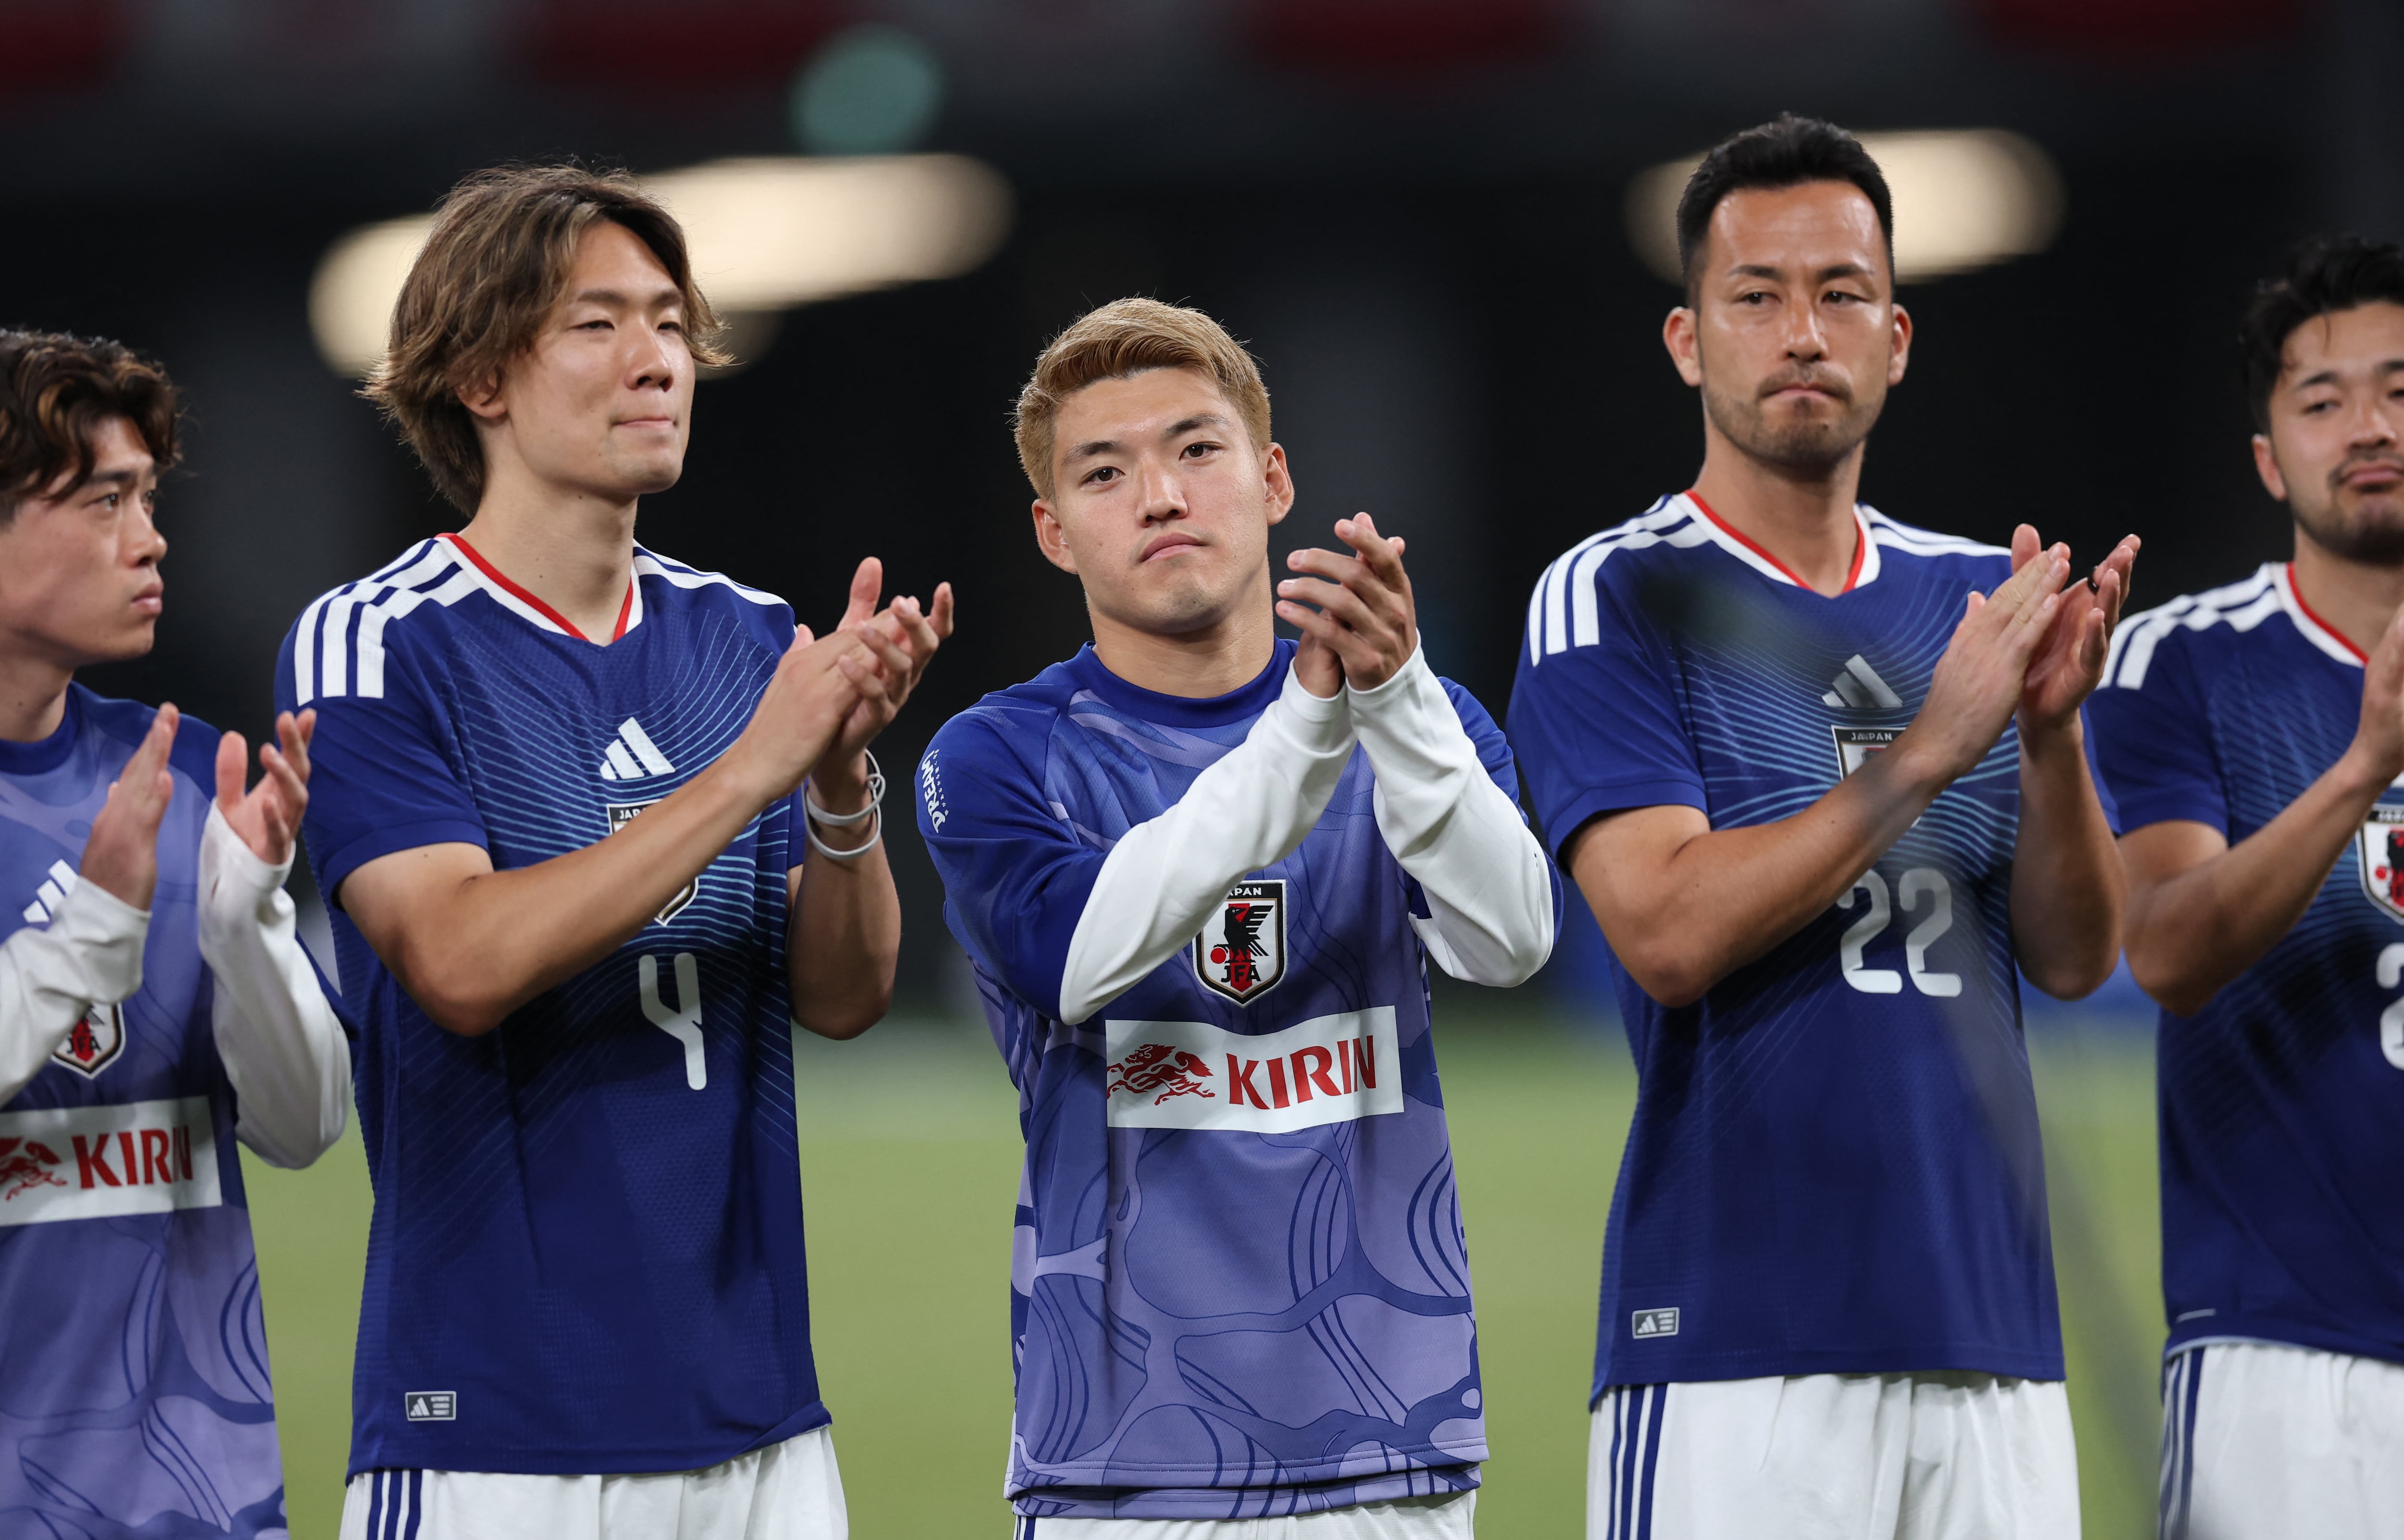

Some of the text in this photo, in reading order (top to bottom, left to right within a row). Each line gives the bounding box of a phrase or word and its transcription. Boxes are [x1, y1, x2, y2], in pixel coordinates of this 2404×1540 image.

[619, 807, 647, 820] JAP
[921, 750, 946, 833] DREAM
[1229, 887, 1262, 896] PAN
[1836, 867, 1963, 997] 22
[1220, 963, 1262, 983] JFA
[67, 1035, 101, 1054] JFA
[639, 952, 707, 1091] 4
[1226, 1035, 1376, 1110] KIRIN
